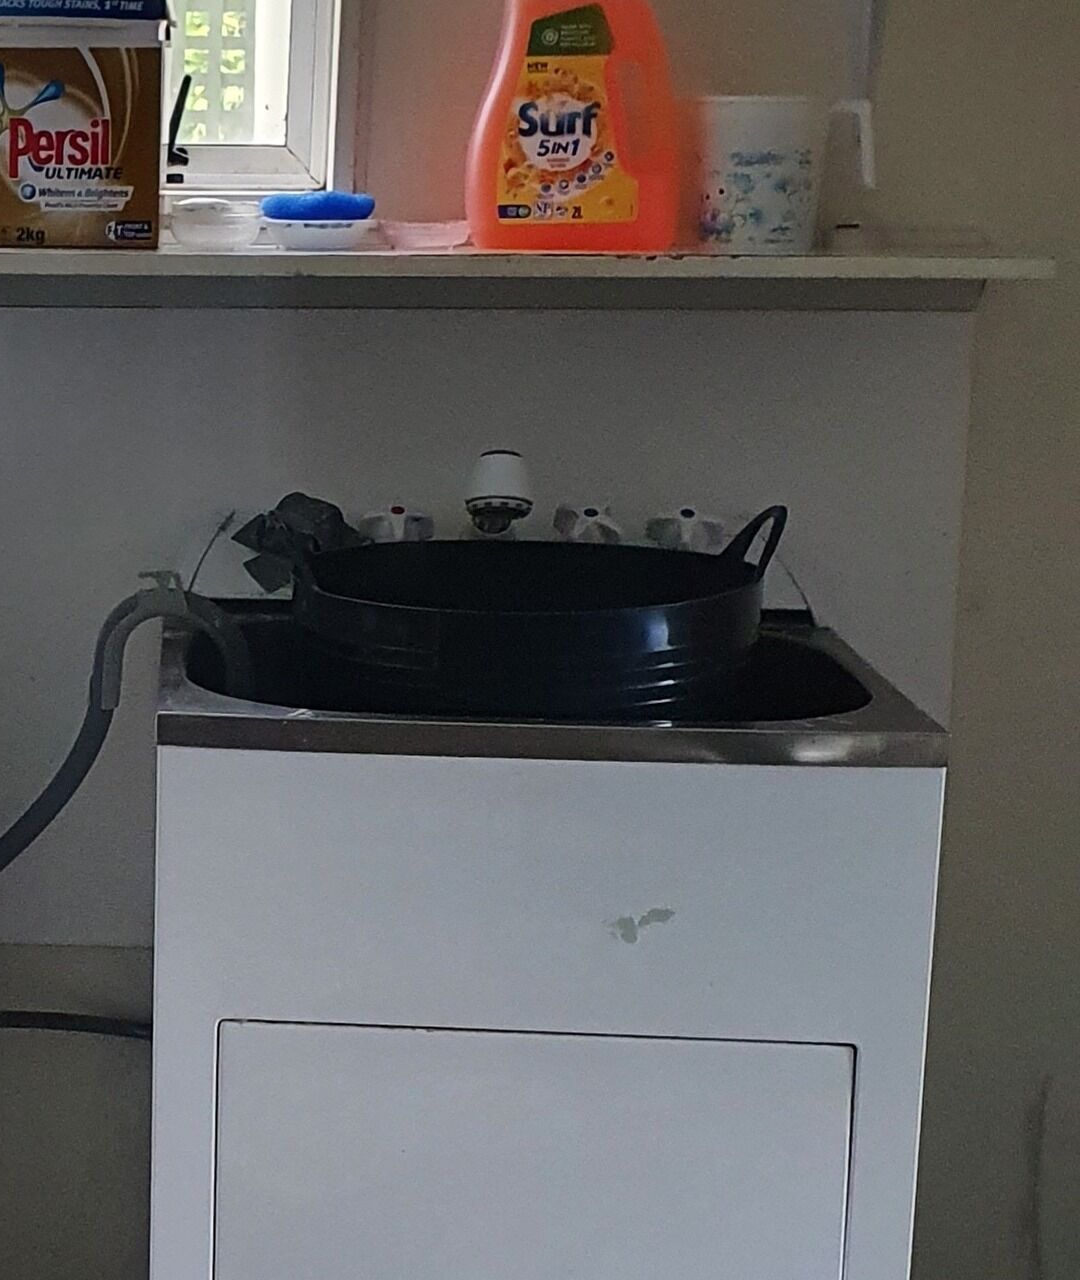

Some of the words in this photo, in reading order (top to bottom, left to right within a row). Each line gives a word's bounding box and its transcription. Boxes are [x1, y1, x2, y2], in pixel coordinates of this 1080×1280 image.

[120, 0, 144, 11] TIME
[518, 101, 601, 138] Surf
[8, 117, 110, 178] Persil
[44, 167, 123, 180] ULTIMATE
[16, 226, 45, 244] 2kg
